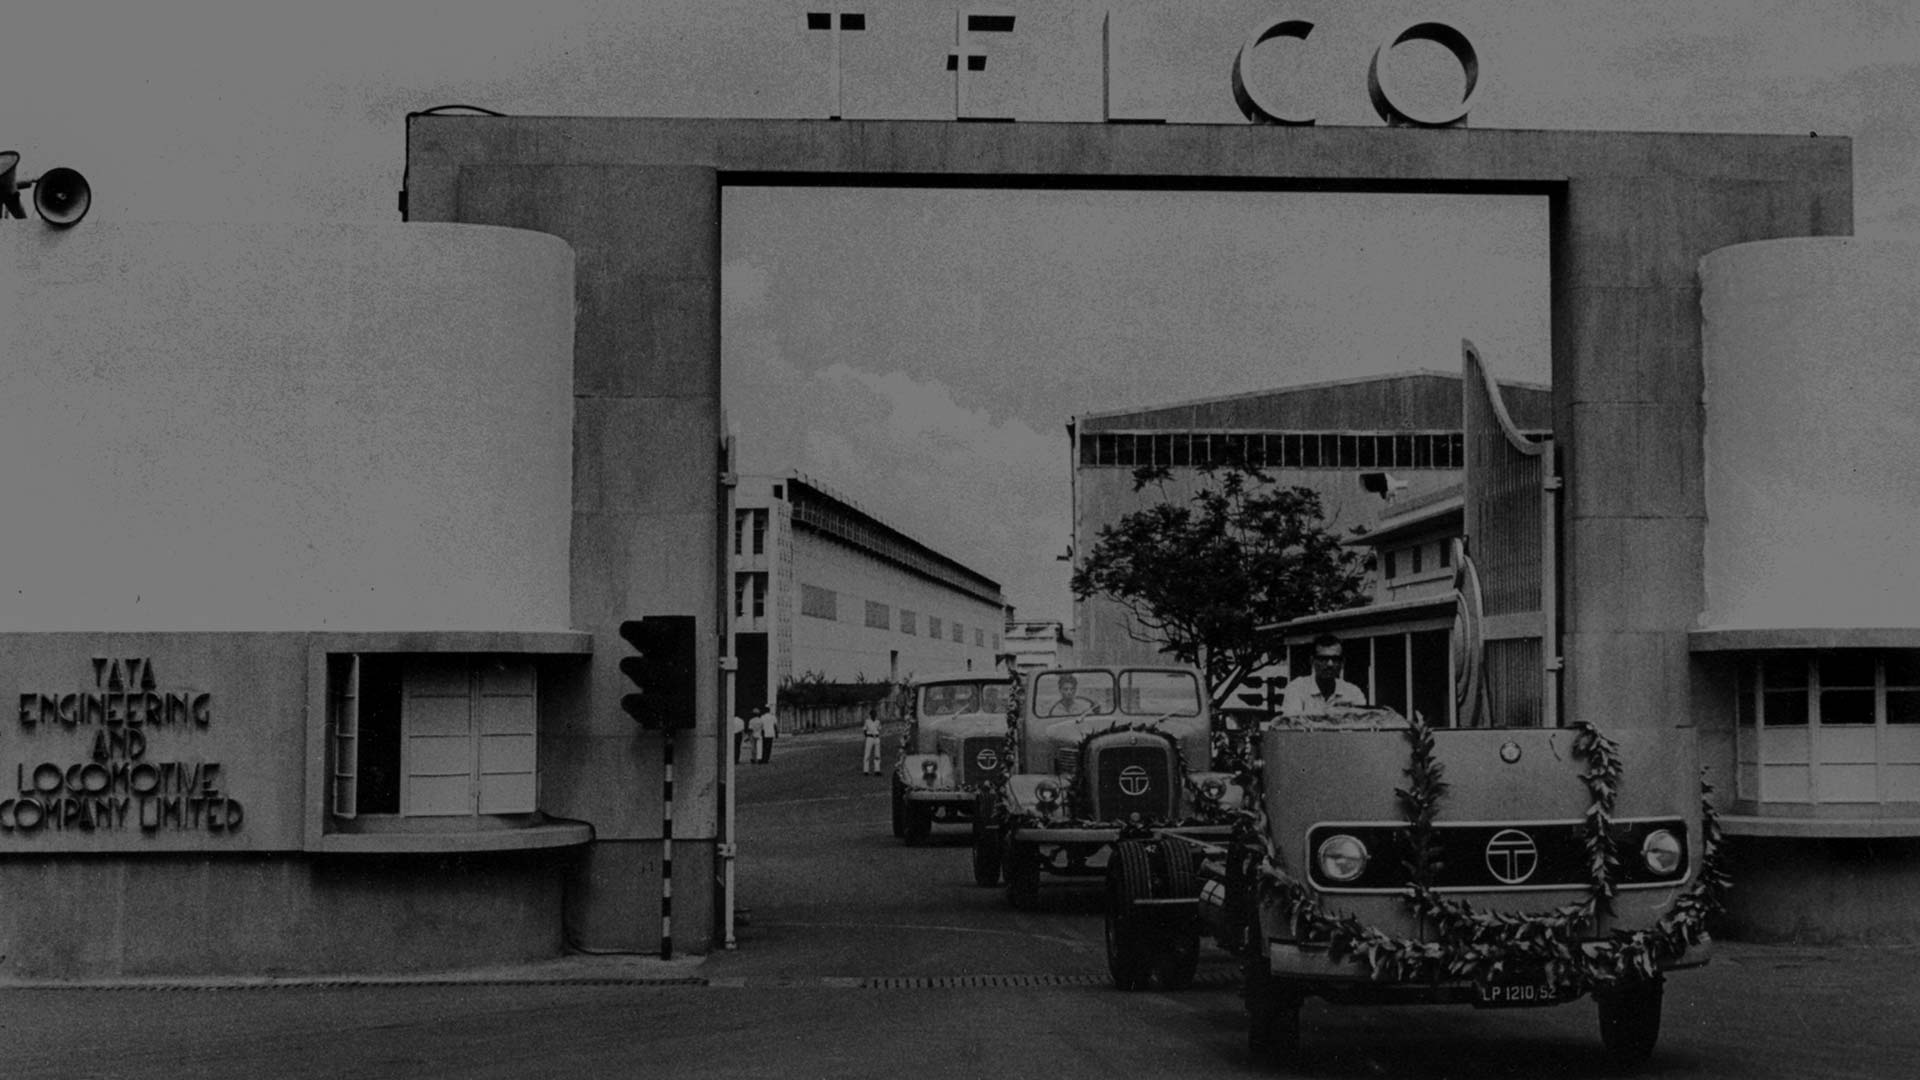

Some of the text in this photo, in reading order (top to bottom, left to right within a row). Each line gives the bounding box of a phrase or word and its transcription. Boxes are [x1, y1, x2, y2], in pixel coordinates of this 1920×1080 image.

[807, 10, 1479, 126] TELCO
[92, 657, 156, 692] TATA
[19, 693, 210, 729] ENGINEERING
[92, 728, 146, 762] AND
[17, 763, 220, 797] LOCOMOTIVE
[0, 797, 243, 833] COMPANY LIMITED
[1481, 986, 1500, 1001] LP
